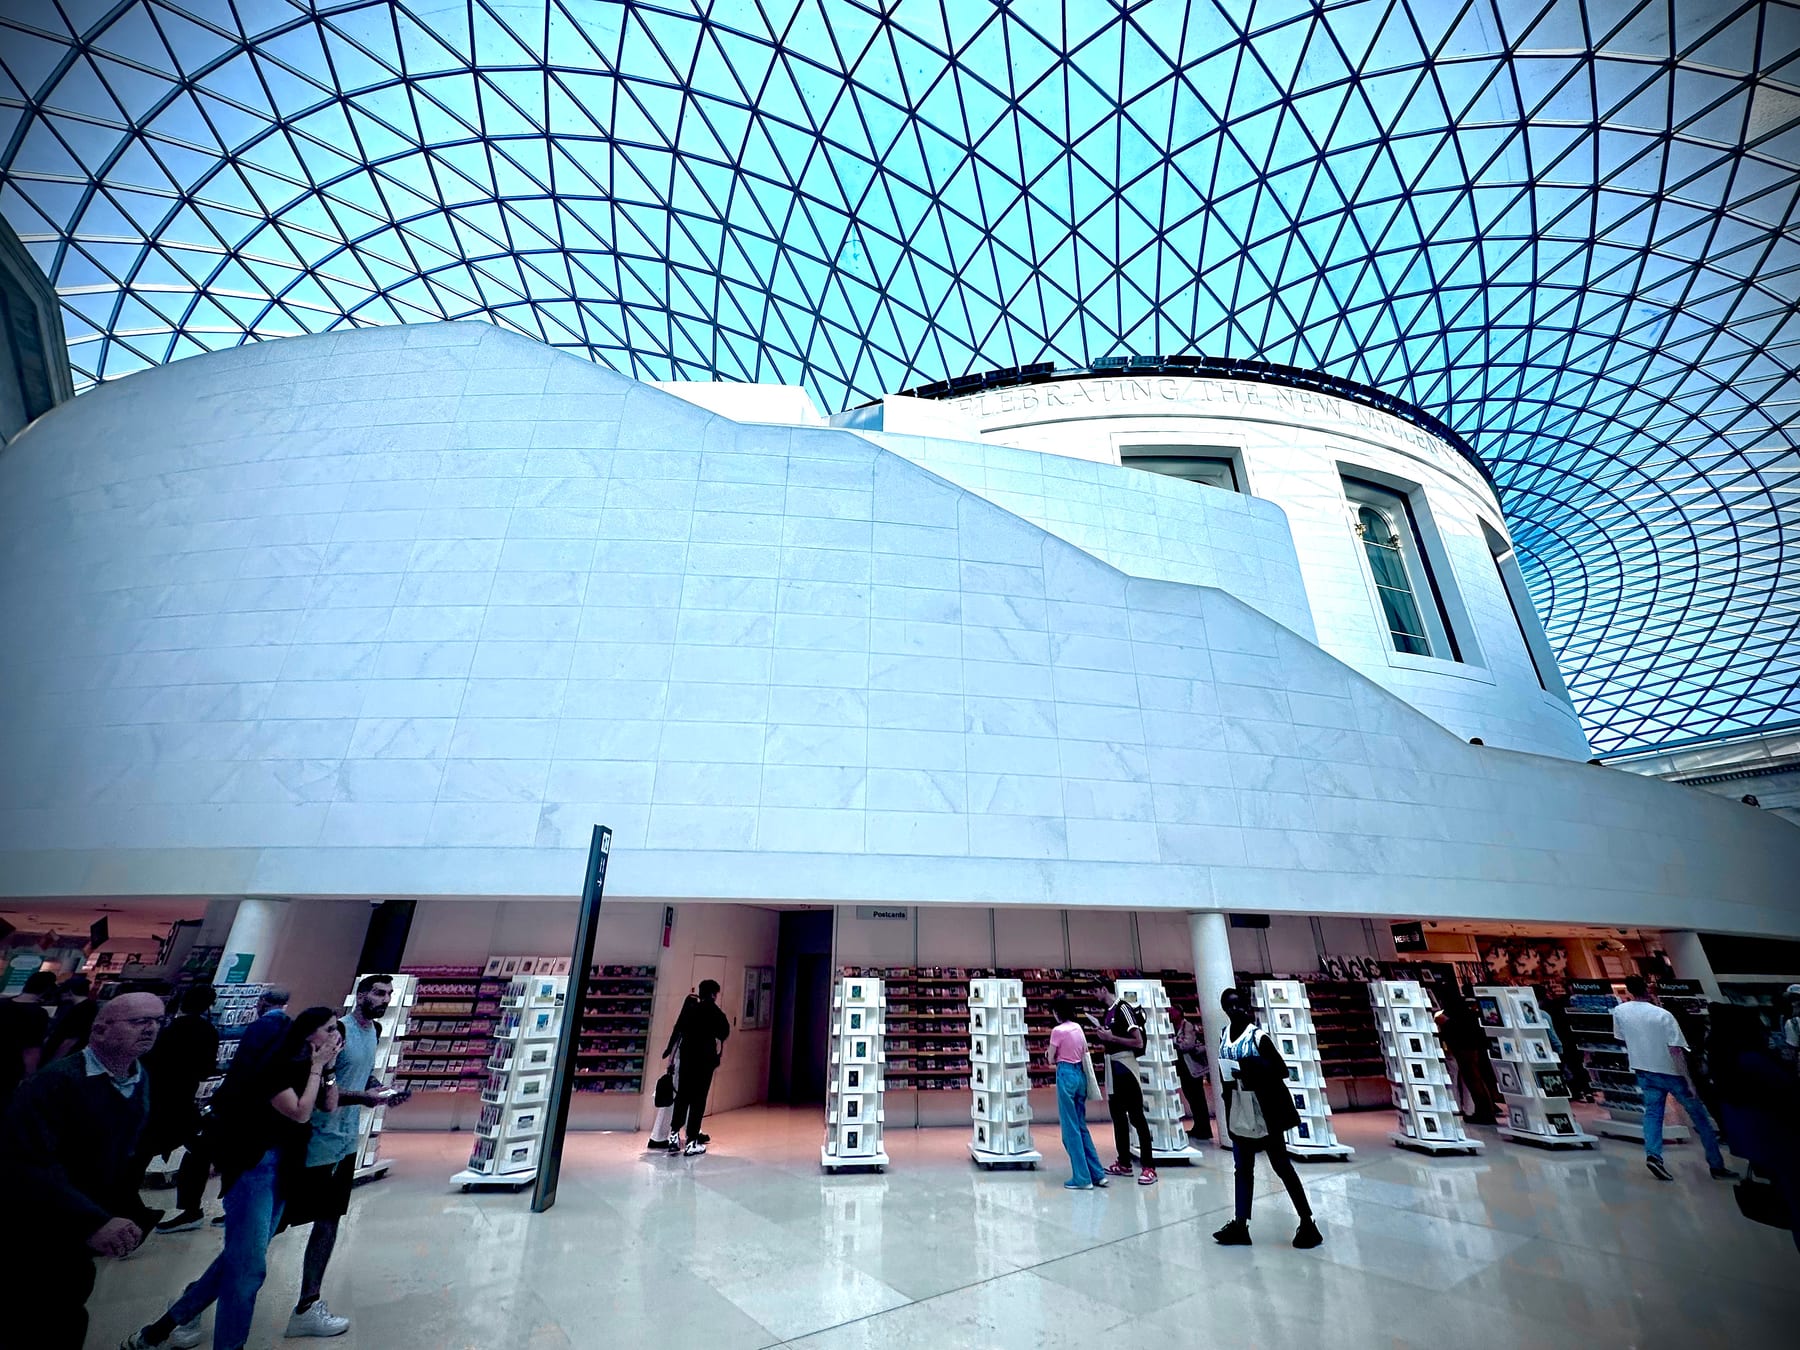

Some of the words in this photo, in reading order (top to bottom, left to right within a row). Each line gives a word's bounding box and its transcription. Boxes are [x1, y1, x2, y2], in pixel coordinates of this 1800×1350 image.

[947, 377, 1180, 418] ELEBRATING
[1191, 380, 1262, 406] THE
[1271, 386, 1342, 419] NEW
[1352, 403, 1488, 492] MILLEN
[873, 910, 906, 918] Postcards
[1572, 982, 1601, 991] Magnets
[1659, 982, 1689, 991] Magnets
